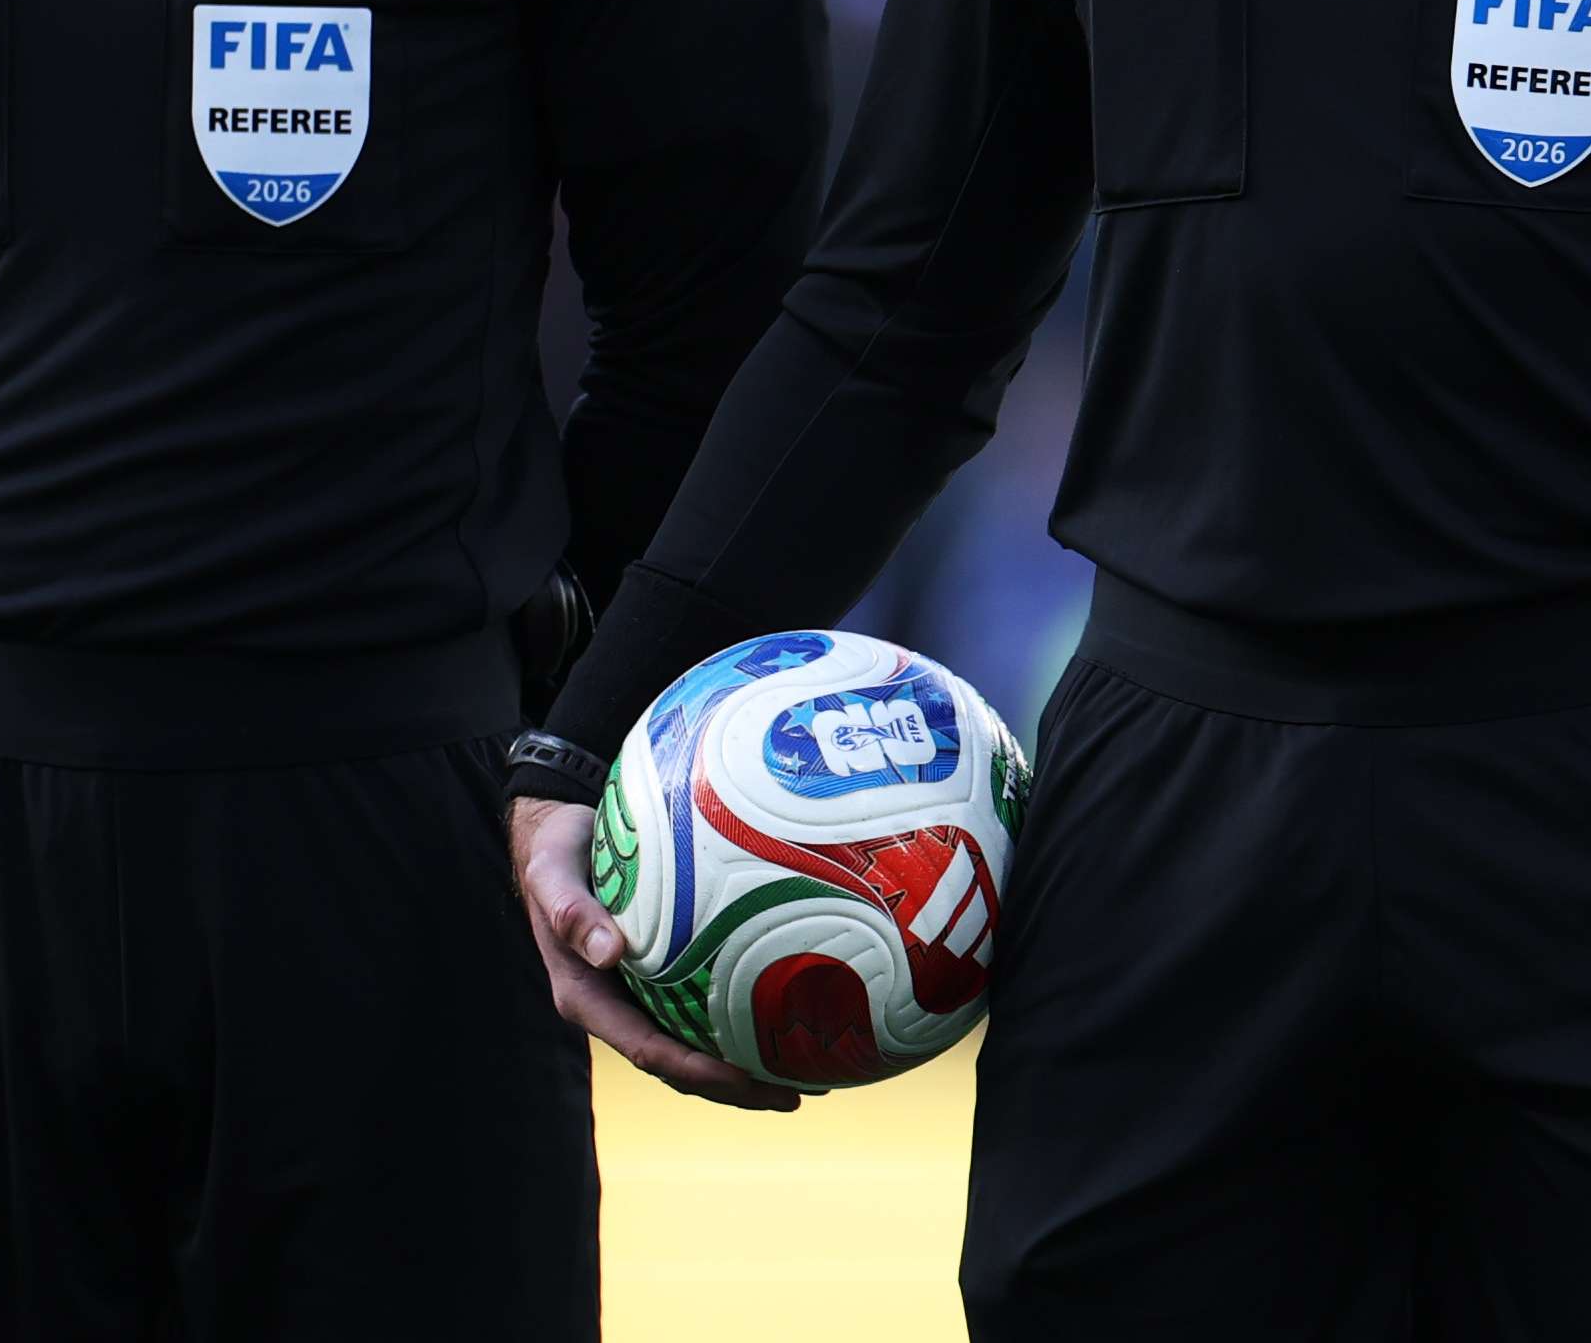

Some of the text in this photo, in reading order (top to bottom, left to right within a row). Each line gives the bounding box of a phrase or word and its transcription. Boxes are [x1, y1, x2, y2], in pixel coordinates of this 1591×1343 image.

[209, 21, 354, 72] FIFA
[208, 107, 353, 135] REFEREE
[1499, 138, 1567, 165] 2026
[246, 179, 312, 203] 2026
[905, 714, 925, 744] FIFA
